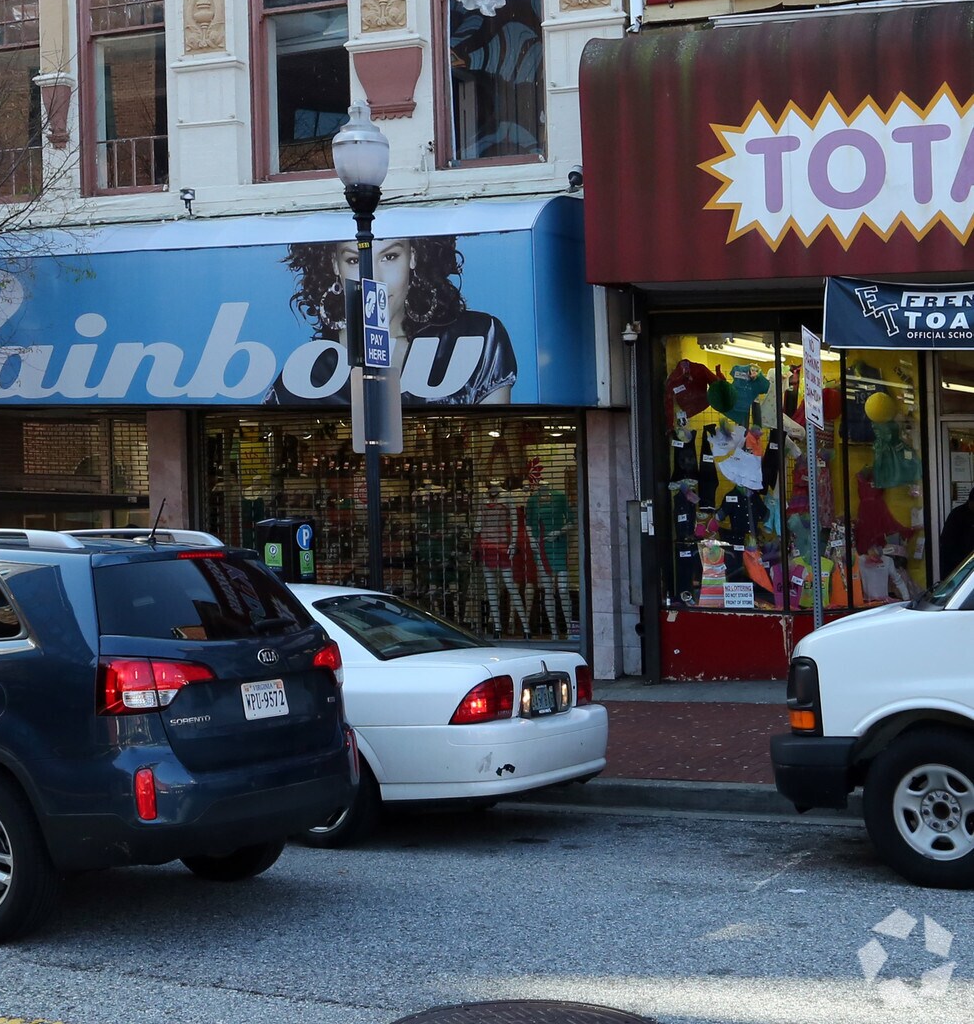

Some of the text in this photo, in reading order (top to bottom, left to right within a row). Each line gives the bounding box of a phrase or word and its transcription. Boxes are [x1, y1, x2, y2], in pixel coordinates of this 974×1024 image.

[904, 311, 970, 329] TOA
[370, 333, 384, 347] PAY
[906, 331, 974, 339] OFFICIAL SCHO
[368, 347, 387, 362] HERE
[170, 715, 211, 726] SORENTO
